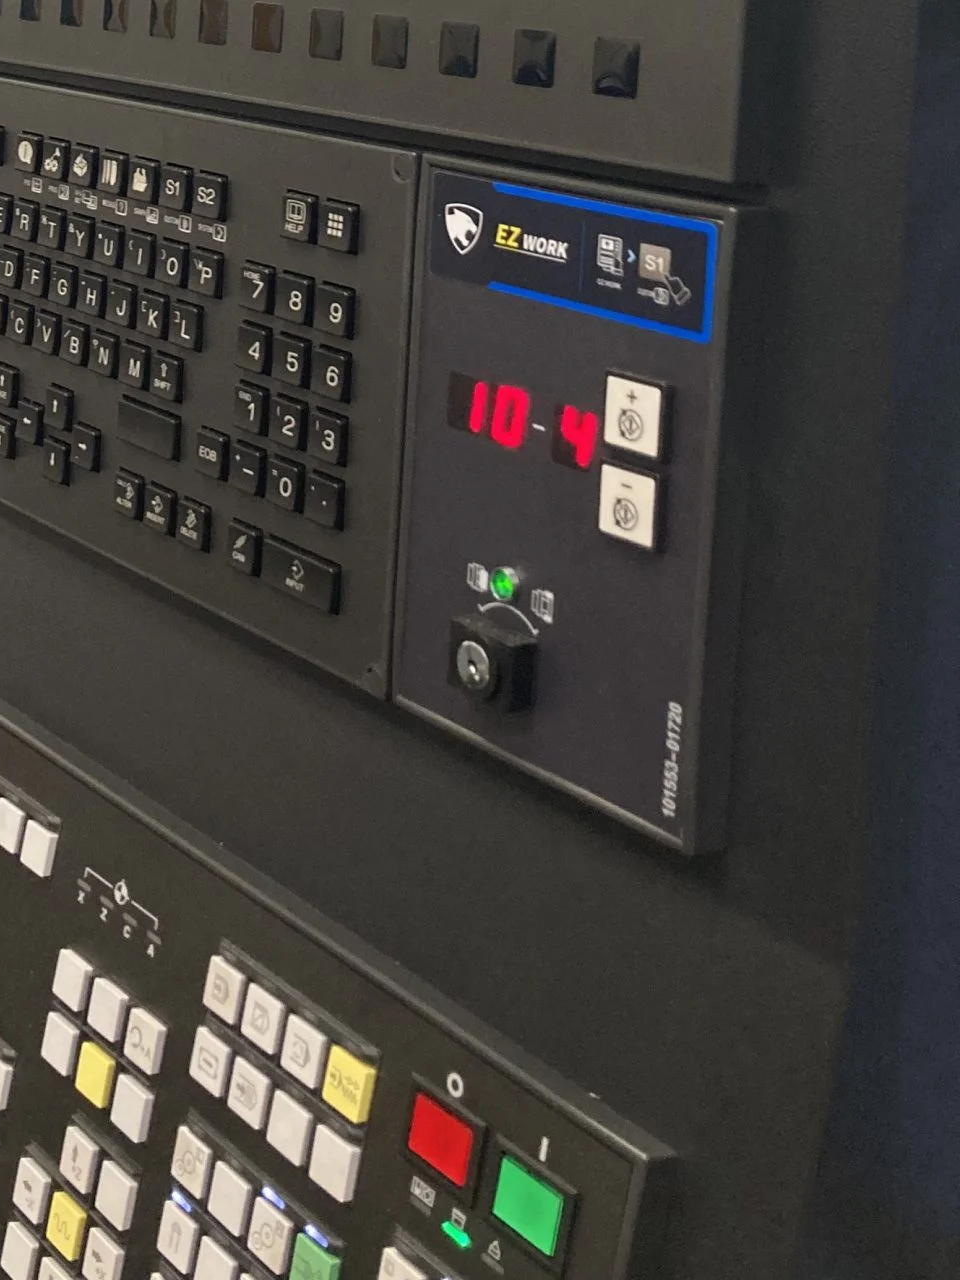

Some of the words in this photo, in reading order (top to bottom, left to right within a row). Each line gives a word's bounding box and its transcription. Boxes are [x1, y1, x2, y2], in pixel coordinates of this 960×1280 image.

[165, 179, 180, 196] S1
[197, 187, 216, 205] S2
[19, 214, 30, 231] R
[47, 221, 57, 238] T
[284, 222, 304, 233] HELP
[75, 229, 85, 247] Y
[103, 238, 114, 256] U
[495, 223, 522, 248] EZ
[522, 233, 569, 260] WORK
[4, 261, 14, 276] D
[644, 253, 664, 272] S1
[30, 269, 40, 284] F
[200, 267, 212, 284] P
[57, 278, 68, 295] G
[252, 279, 264, 298] 7
[85, 287, 97, 306] H
[289, 290, 302, 311] 8
[116, 299, 126, 316] J
[329, 302, 342, 323] 9
[14, 317, 25, 334] C
[147, 308, 159, 328] K
[42, 325, 52, 343] V
[180, 319, 190, 340] L
[69, 336, 80, 354] B
[248, 341, 260, 360] 4
[98, 346, 109, 366] N
[286, 351, 299, 372] 5
[128, 358, 140, 378] M
[326, 366, 339, 387] 6
[247, 403, 255, 421] 1
[282, 415, 296, 437] 2
[321, 429, 335, 451] 3
[198, 445, 217, 462] EOB
[279, 477, 292, 497] 0
[285, 577, 305, 592] INPUT
[661, 701, 682, 818] 101553-01720
[77, 890, 86, 904] X
[100, 907, 108, 922] Z
[123, 925, 131, 939] C
[147, 944, 155, 957] A
